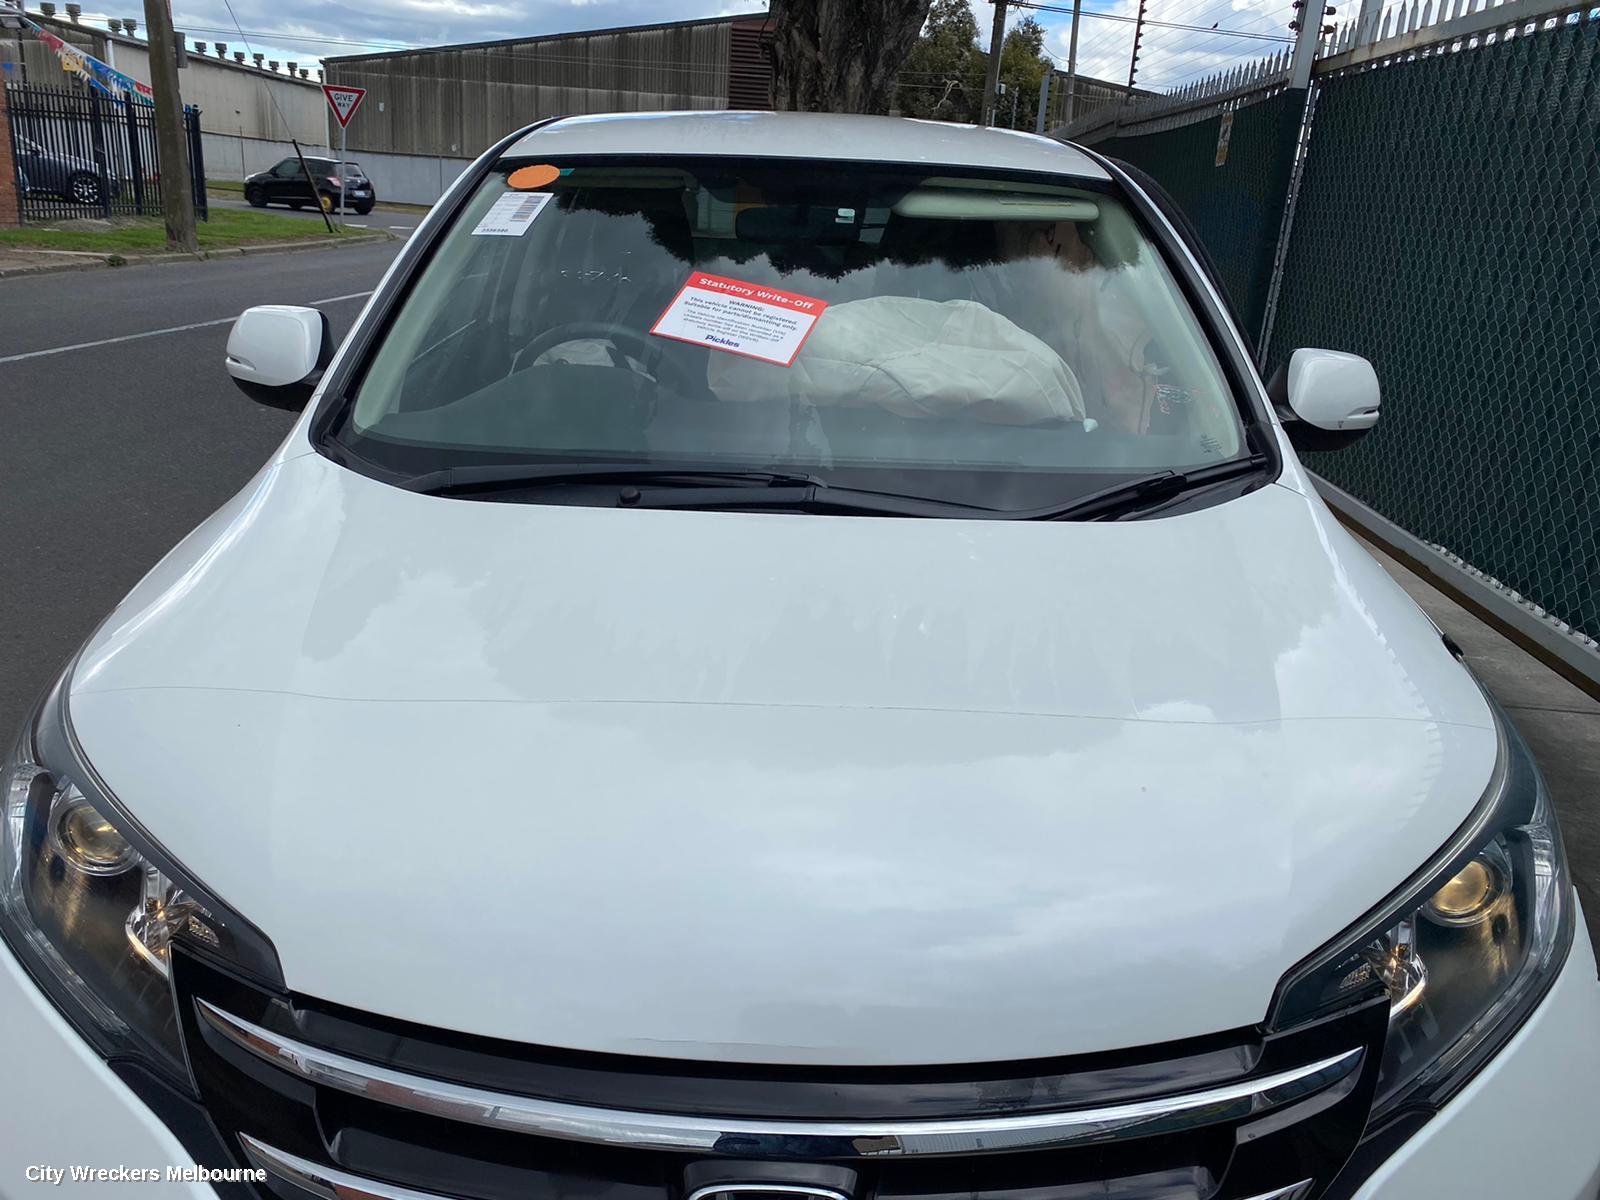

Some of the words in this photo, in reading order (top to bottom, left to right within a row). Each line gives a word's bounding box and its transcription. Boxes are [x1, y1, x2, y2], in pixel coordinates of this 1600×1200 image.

[334, 93, 353, 102] GIVE
[698, 278, 754, 295] Statutory
[756, 290, 814, 308] Write-Off
[703, 299, 728, 308] vehicle
[728, 305, 752, 314] cannot
[728, 300, 765, 311] WARNING:
[704, 334, 741, 347] Pickles
